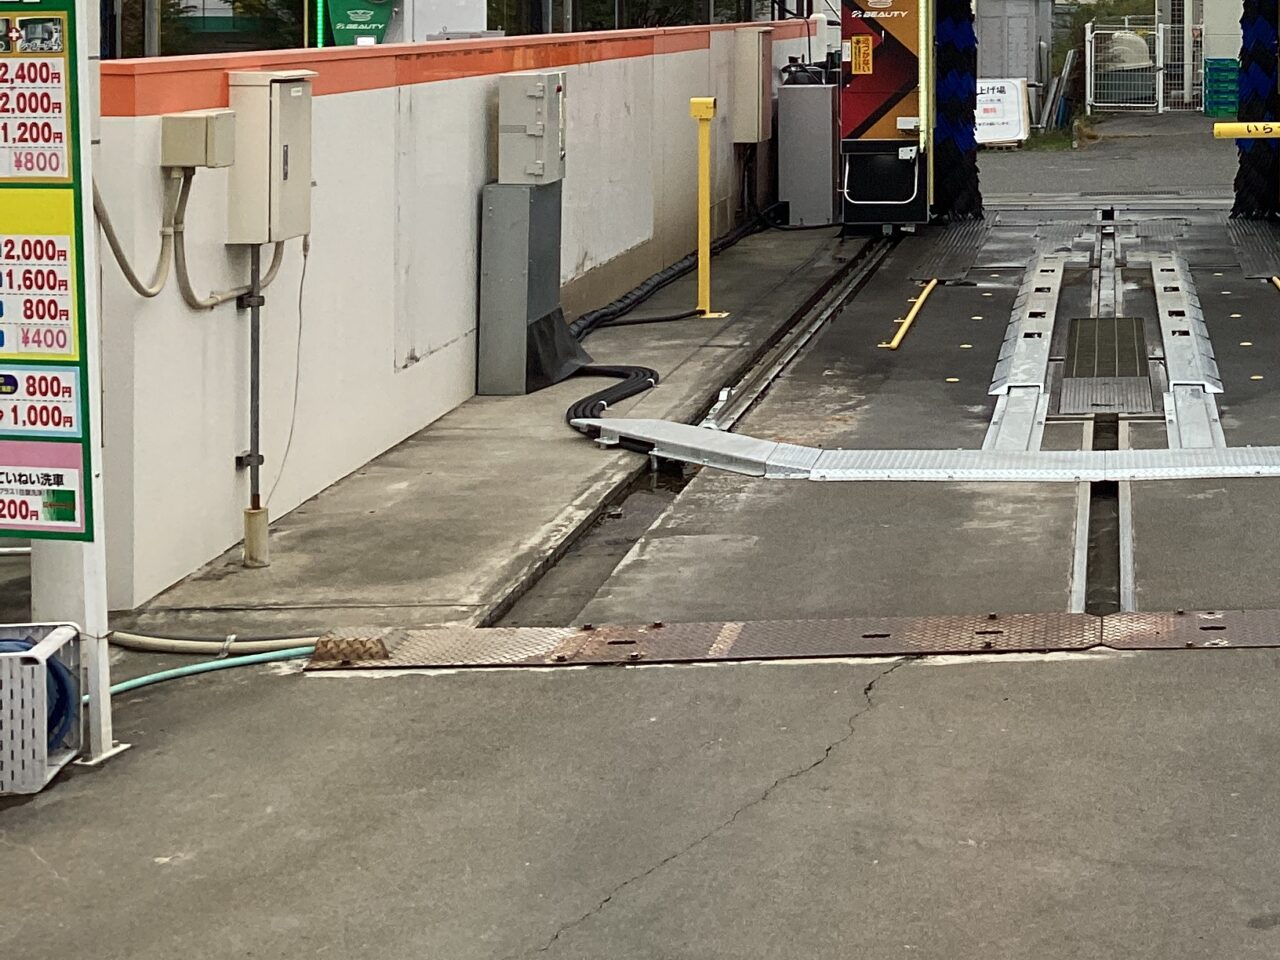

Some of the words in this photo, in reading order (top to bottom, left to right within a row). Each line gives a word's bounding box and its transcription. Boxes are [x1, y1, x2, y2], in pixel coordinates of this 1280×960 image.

[0, 62, 61, 84] 2,400円
[0, 92, 62, 114] 2,000円
[1, 122, 63, 144] 1,200円
[13, 151, 60, 172] ¥800
[3, 239, 67, 261] 2,000円
[6, 269, 68, 291] 1,600円
[23, 299, 69, 321] 800円
[21, 327, 67, 349] ¥400
[25, 375, 72, 398] 800円
[11, 405, 73, 428] 1,000円
